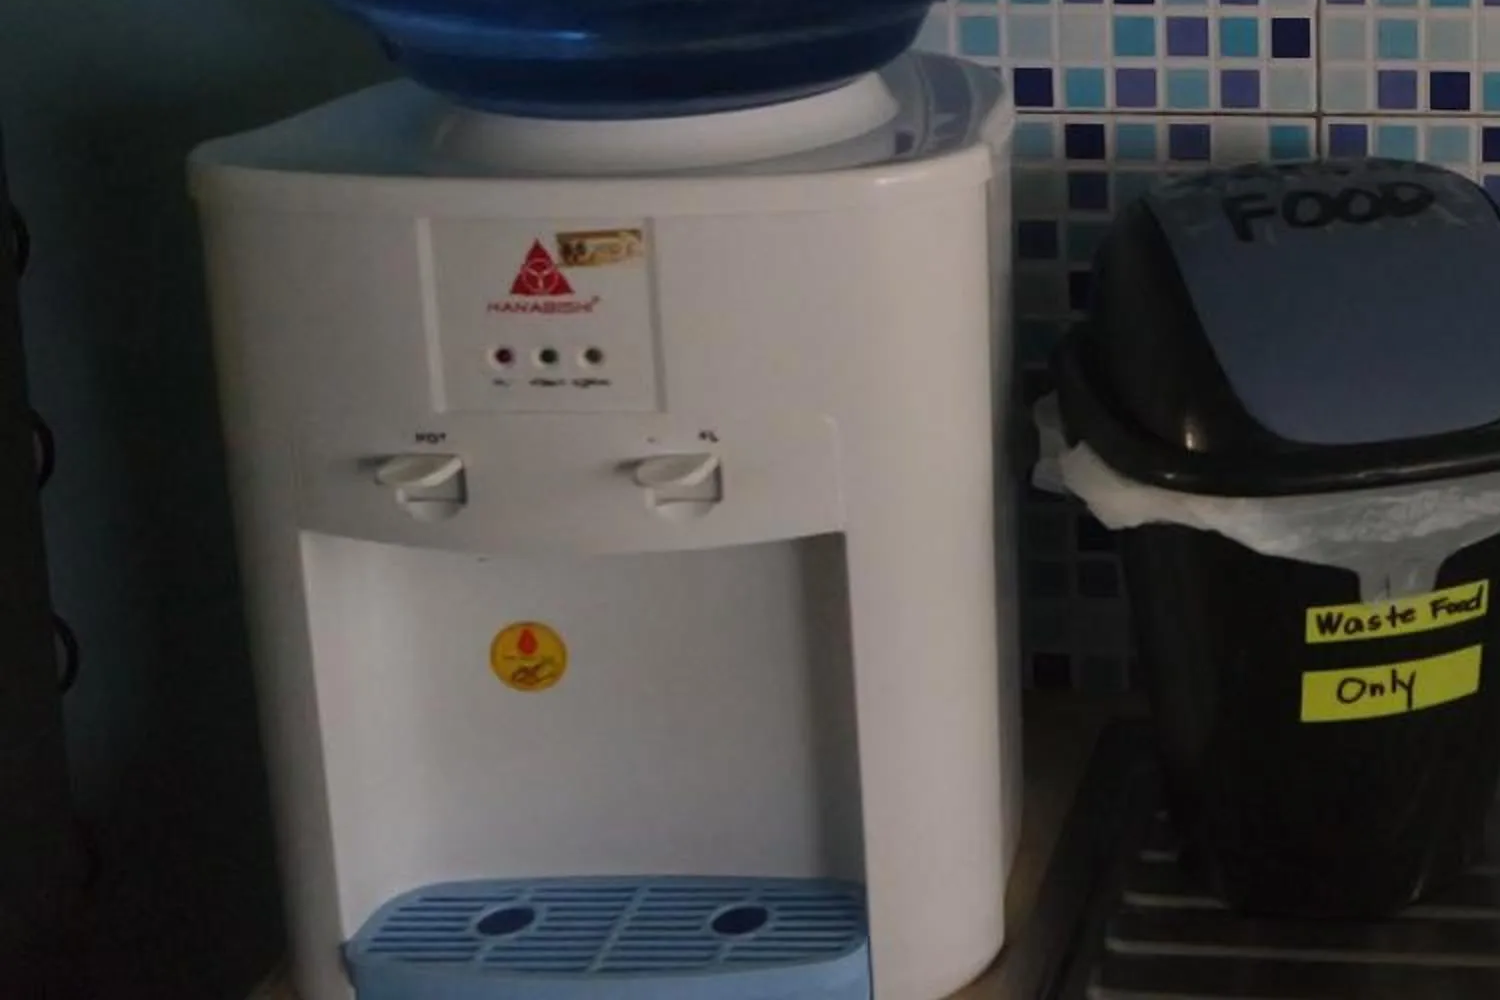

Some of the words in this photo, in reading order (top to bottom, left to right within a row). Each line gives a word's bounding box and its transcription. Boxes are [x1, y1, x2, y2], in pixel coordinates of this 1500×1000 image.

[1222, 180, 1436, 243] FOOD
[1315, 601, 1418, 637] Waste
[1429, 585, 1485, 622] Food
[1335, 669, 1418, 710] Only
